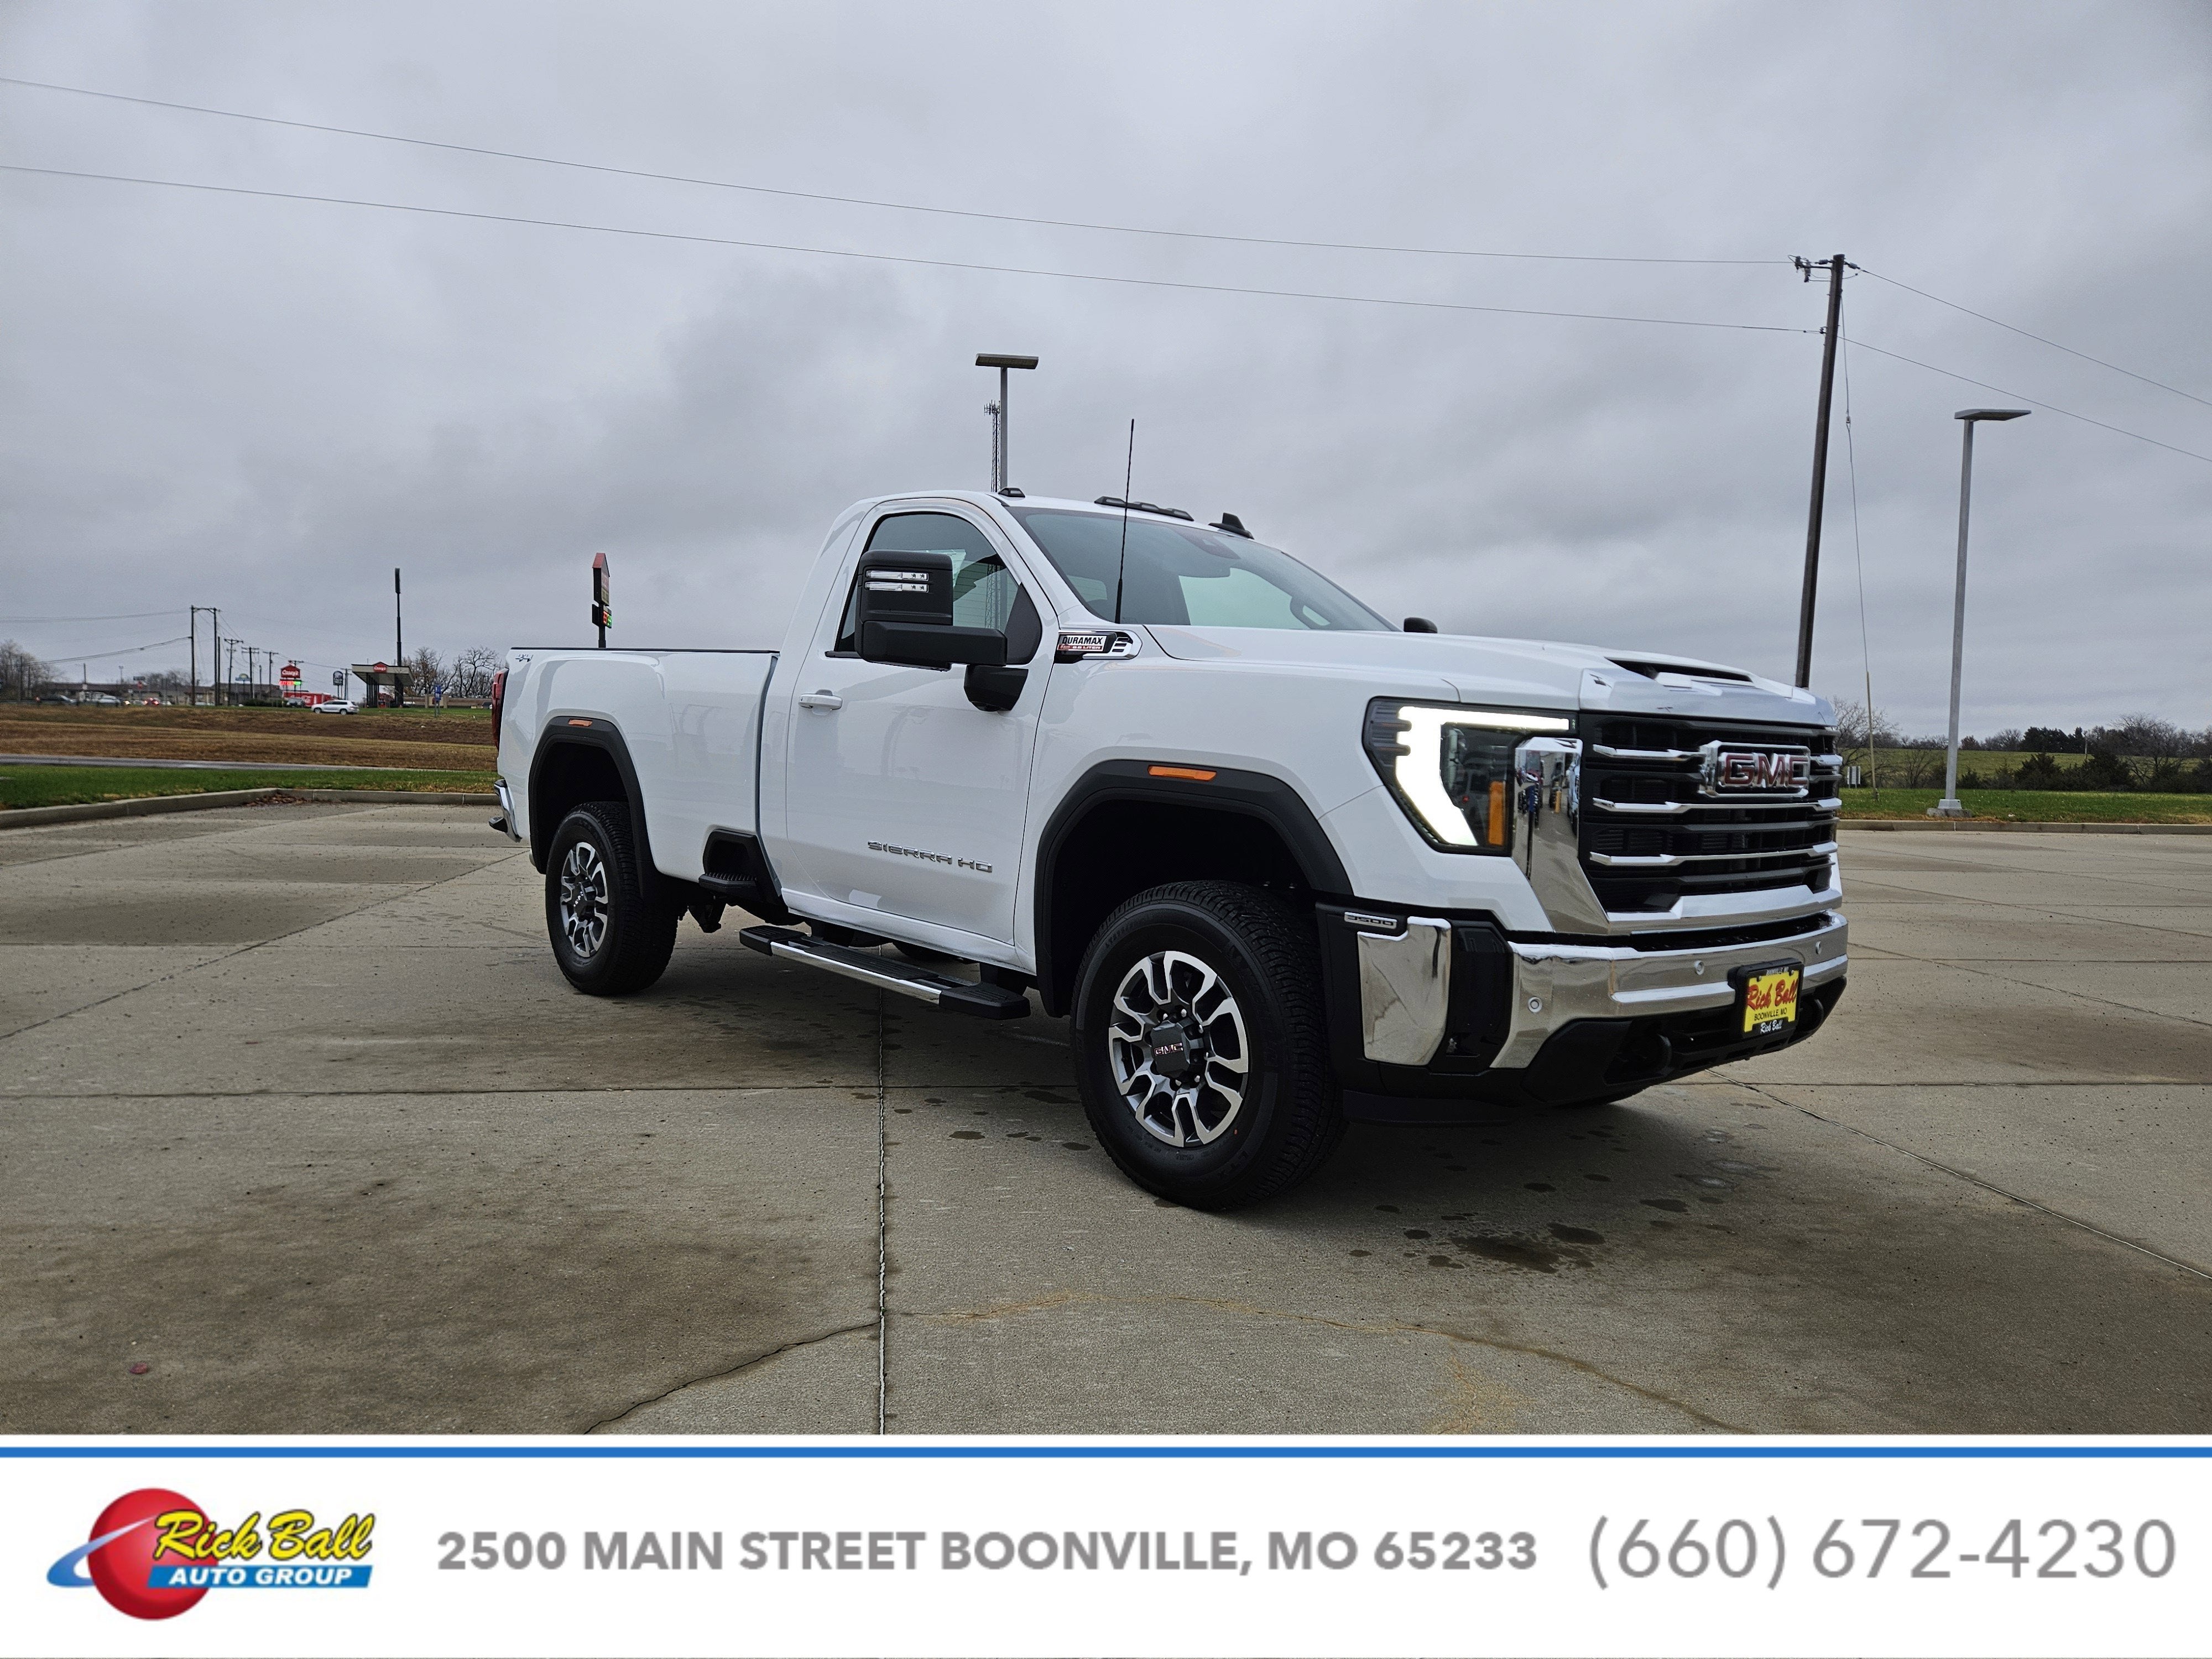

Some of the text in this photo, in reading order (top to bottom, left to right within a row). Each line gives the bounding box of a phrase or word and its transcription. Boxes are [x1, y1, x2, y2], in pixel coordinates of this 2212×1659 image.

[1062, 637, 1103, 645] DURAMAX
[1719, 752, 1809, 787] GMC
[868, 841, 993, 873] SIERRA HD
[1347, 914, 1394, 926] 3500
[1747, 978, 1799, 1011] Rick Ball
[1154, 1042, 1183, 1056] GMC
